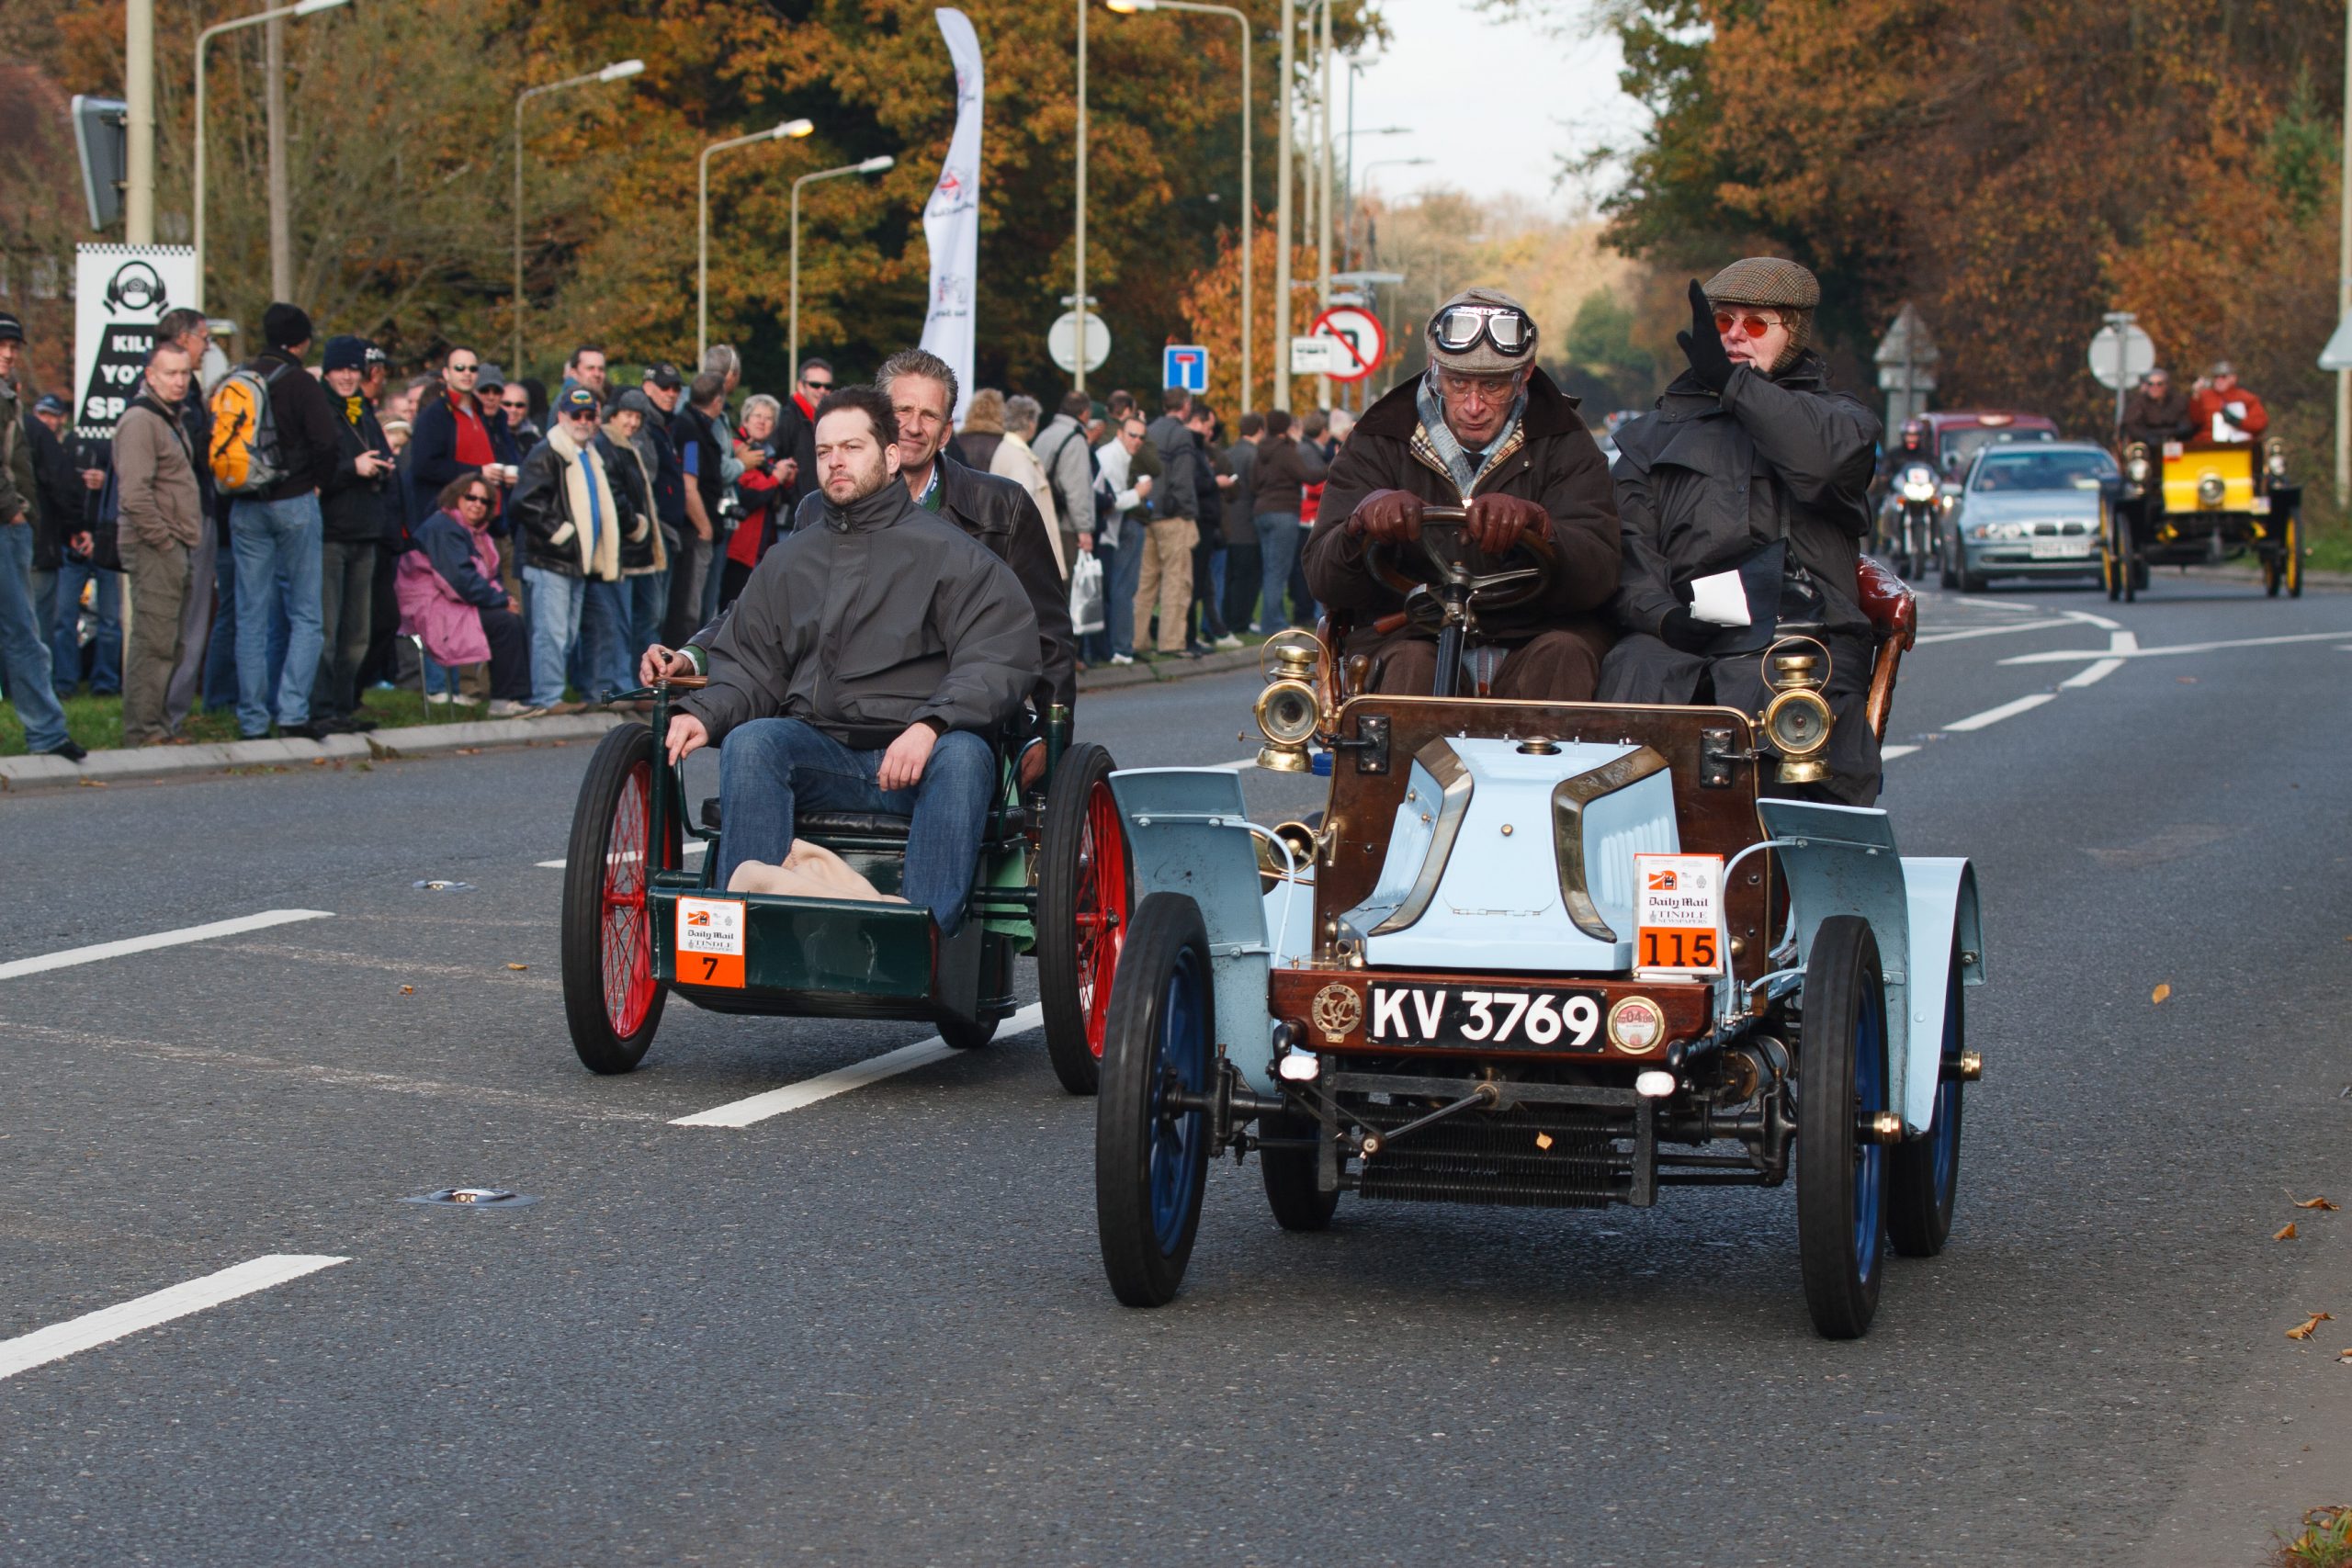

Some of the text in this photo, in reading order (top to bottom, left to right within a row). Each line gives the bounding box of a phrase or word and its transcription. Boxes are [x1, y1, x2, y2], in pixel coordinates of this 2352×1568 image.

[100, 364, 143, 385] YO
[1649, 897, 1708, 908] Daily Mail
[1658, 910, 1707, 919] TINDLE
[688, 930, 711, 940] Daily
[1645, 933, 1715, 966] 115
[703, 956, 718, 980] 7
[1374, 988, 1447, 1039] KV
[1460, 991, 1600, 1045] 3769
